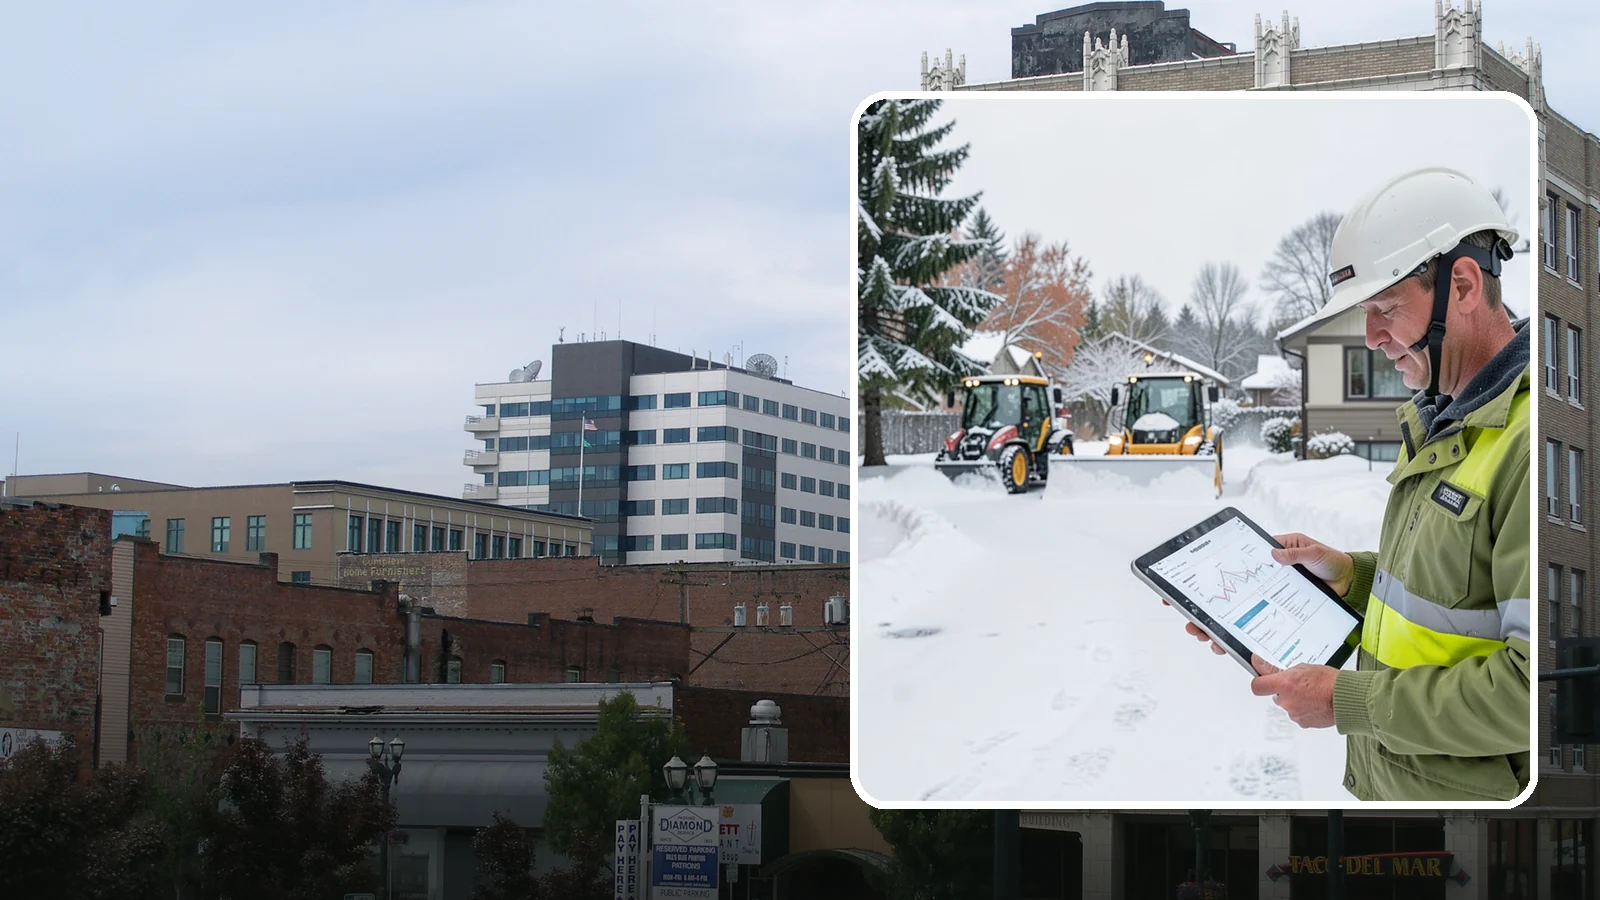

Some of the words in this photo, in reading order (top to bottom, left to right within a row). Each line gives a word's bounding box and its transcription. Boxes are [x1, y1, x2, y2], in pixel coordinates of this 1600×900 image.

[343, 567, 368, 577] Home
[370, 565, 427, 577] Furnishers
[660, 818, 713, 832] DIAMOND
[1022, 815, 1070, 828] BUILDING
[720, 824, 740, 835] ETT
[617, 825, 625, 852] PAY
[628, 824, 636, 852] PAY
[720, 840, 740, 848] ANT
[656, 845, 688, 853] RESERVED
[722, 852, 738, 862] Soup
[1346, 856, 1385, 876] DEL
[1392, 858, 1442, 877] MAR
[616, 856, 624, 894] HERE
[628, 856, 636, 894] HERE
[660, 888, 682, 897] PUBLIC
[684, 890, 710, 898] PARKING
